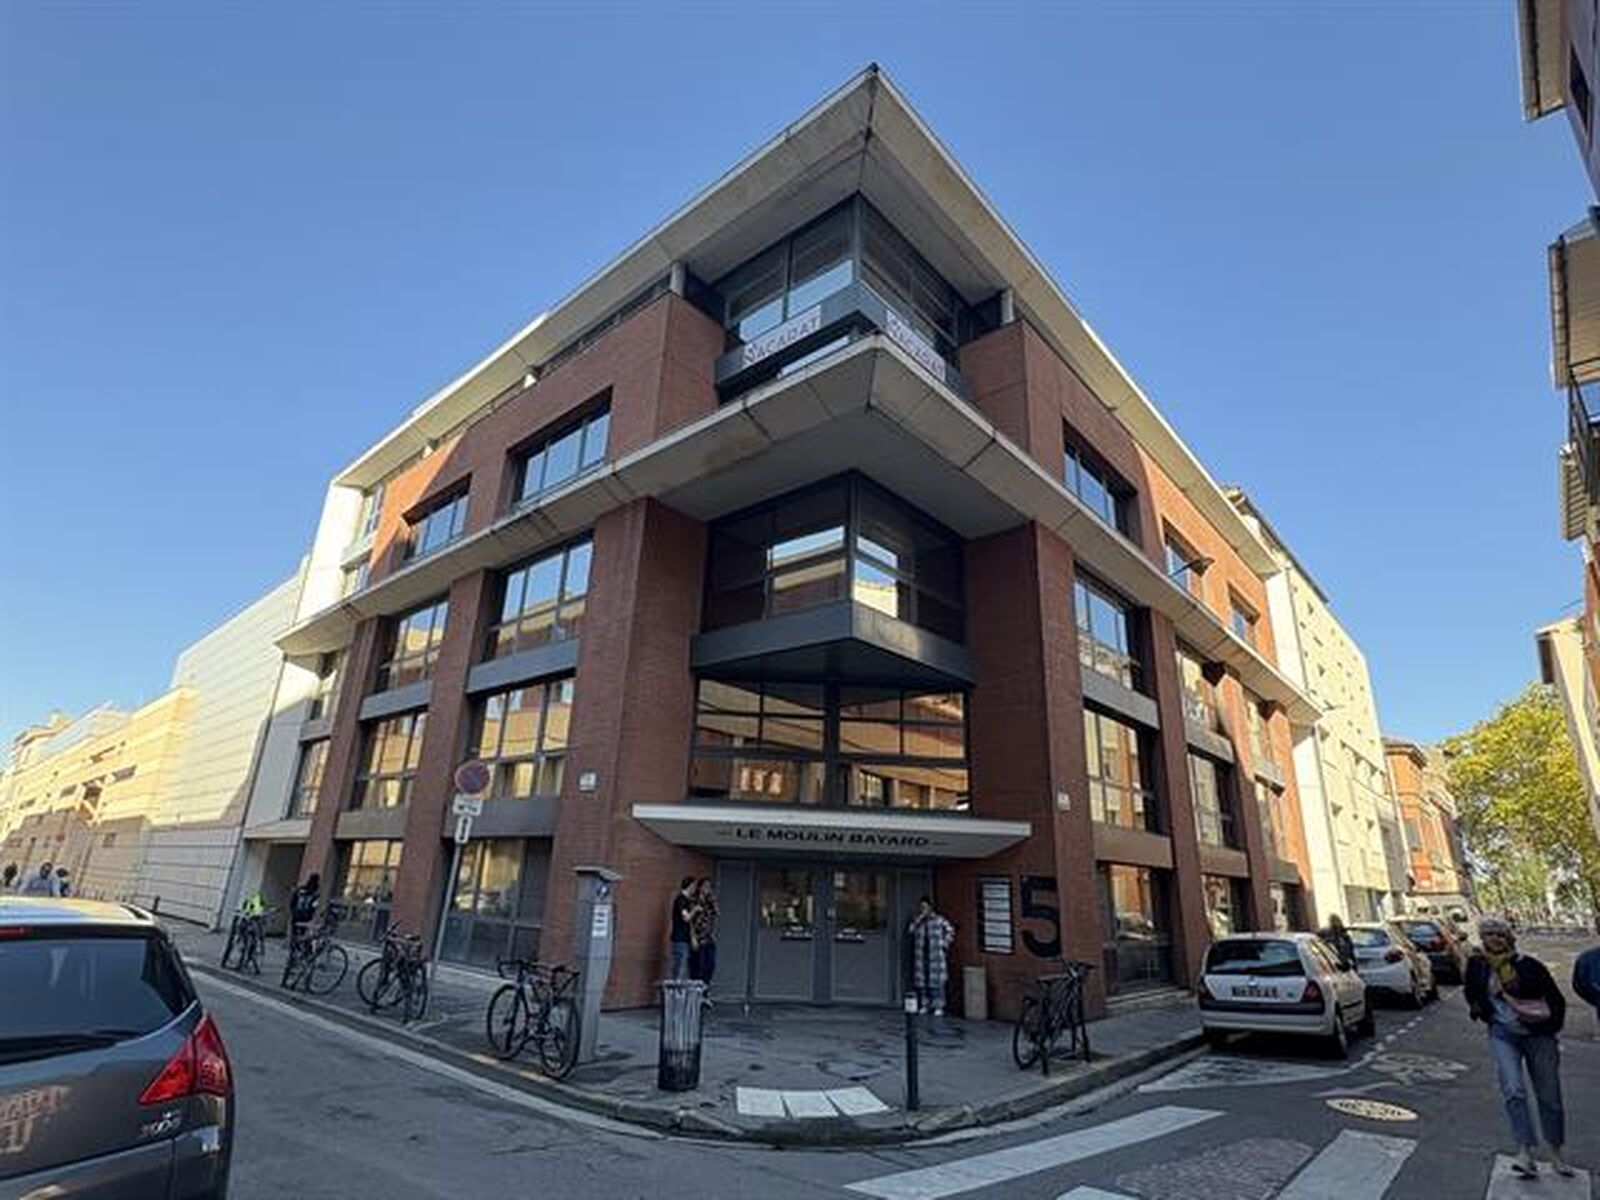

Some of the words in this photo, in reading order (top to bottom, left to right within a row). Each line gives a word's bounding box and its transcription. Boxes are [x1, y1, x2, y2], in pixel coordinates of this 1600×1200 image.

[736, 828, 762, 841] LE
[766, 829, 845, 843] MOULIN
[849, 832, 930, 847] BAYARD
[1020, 876, 1062, 958] 5
